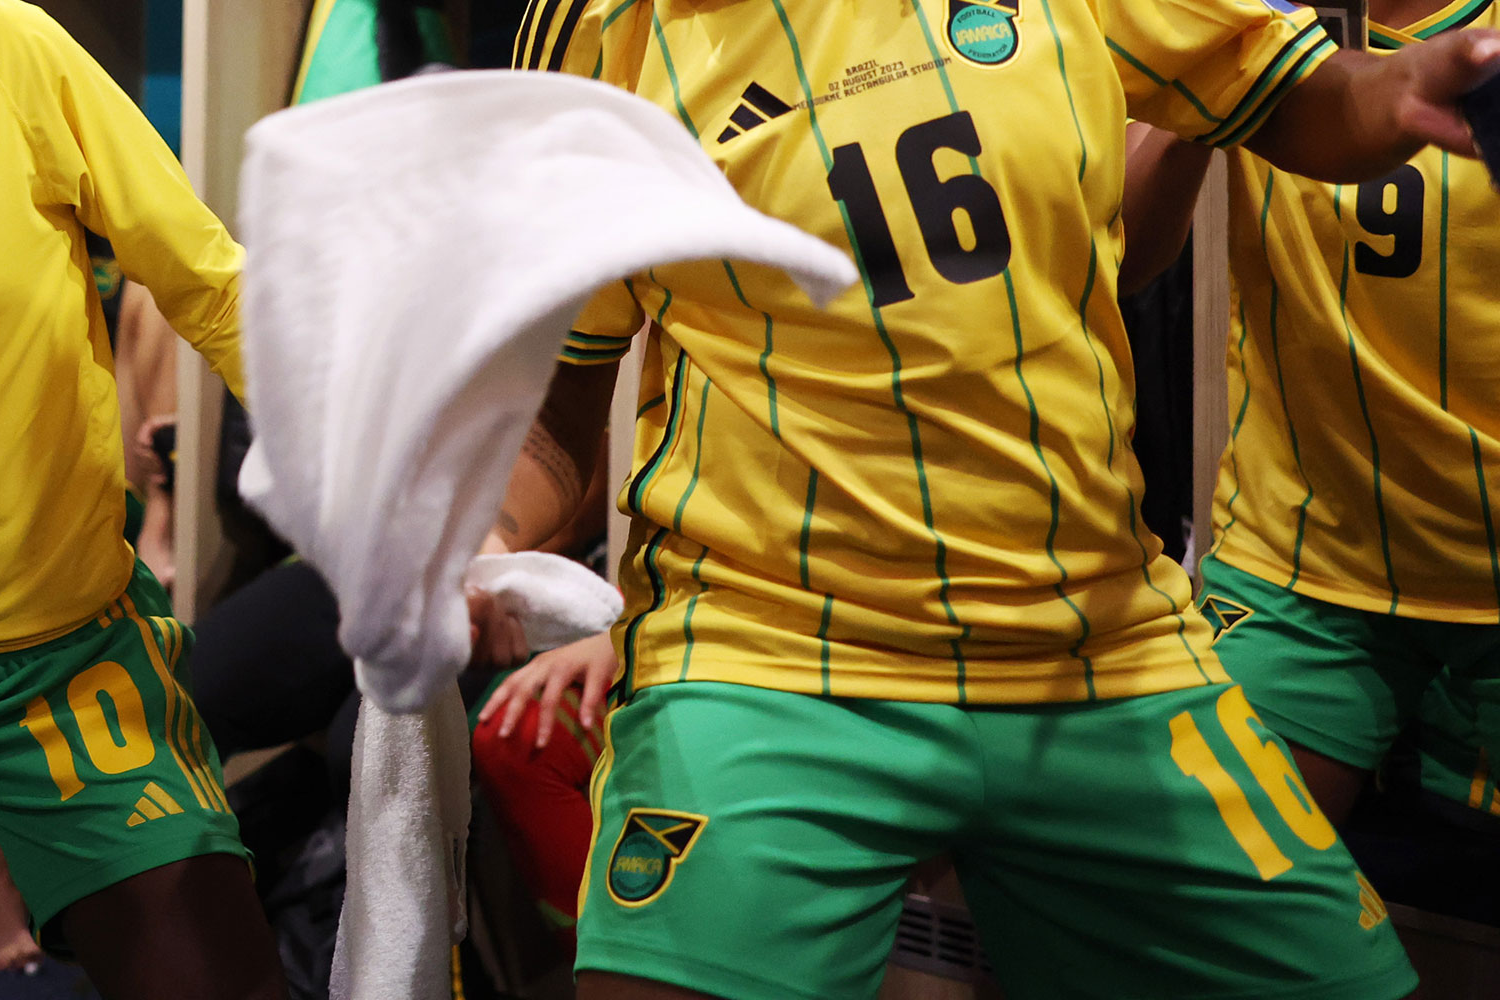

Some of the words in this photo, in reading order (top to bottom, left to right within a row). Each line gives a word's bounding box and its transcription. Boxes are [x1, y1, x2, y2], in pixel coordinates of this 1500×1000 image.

[845, 59, 880, 76] BRAZIL
[955, 21, 1012, 47] JAMAICA
[842, 70, 878, 87] AUGUST
[880, 60, 905, 75] 2023
[844, 70, 909, 97] RECTANGULAR
[826, 109, 1012, 309] 16
[1354, 163, 1425, 279] 9
[18, 660, 156, 801] 10
[1168, 684, 1337, 882] 16
